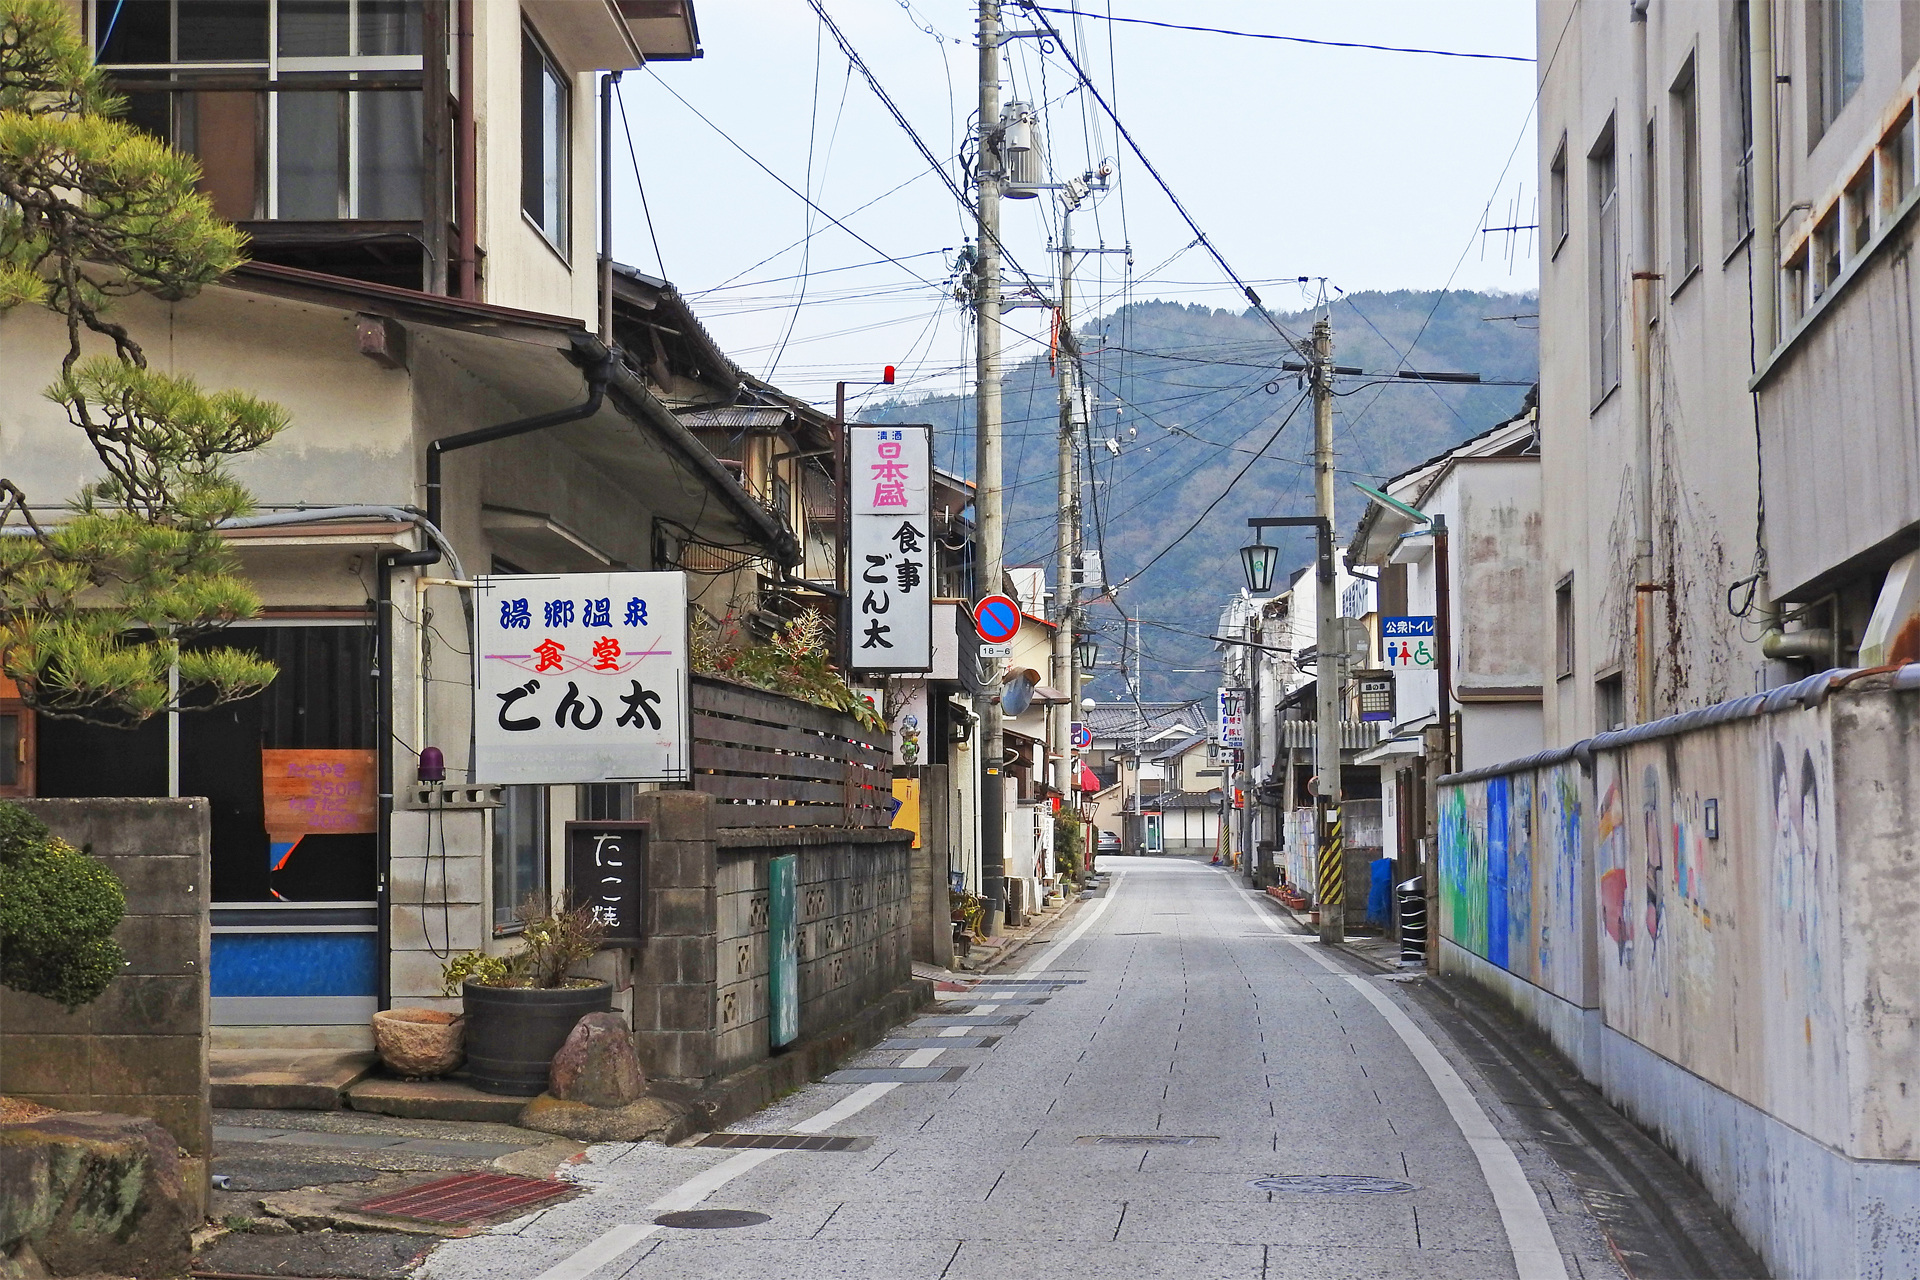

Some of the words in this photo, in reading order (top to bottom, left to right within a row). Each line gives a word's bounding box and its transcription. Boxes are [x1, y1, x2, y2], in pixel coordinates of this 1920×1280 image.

[878, 430, 902, 441] 清酒
[871, 442, 909, 508] 日本盛
[891, 520, 925, 594] 食事
[500, 597, 649, 630] 湯郷温泉
[860, 553, 894, 649] ごん太
[1386, 620, 1434, 634] 公衆トイレ
[533, 635, 622, 672] 食堂
[496, 679, 662, 732] ごん太
[286, 762, 346, 778] たこやき
[591, 833, 623, 928] たこ焼
